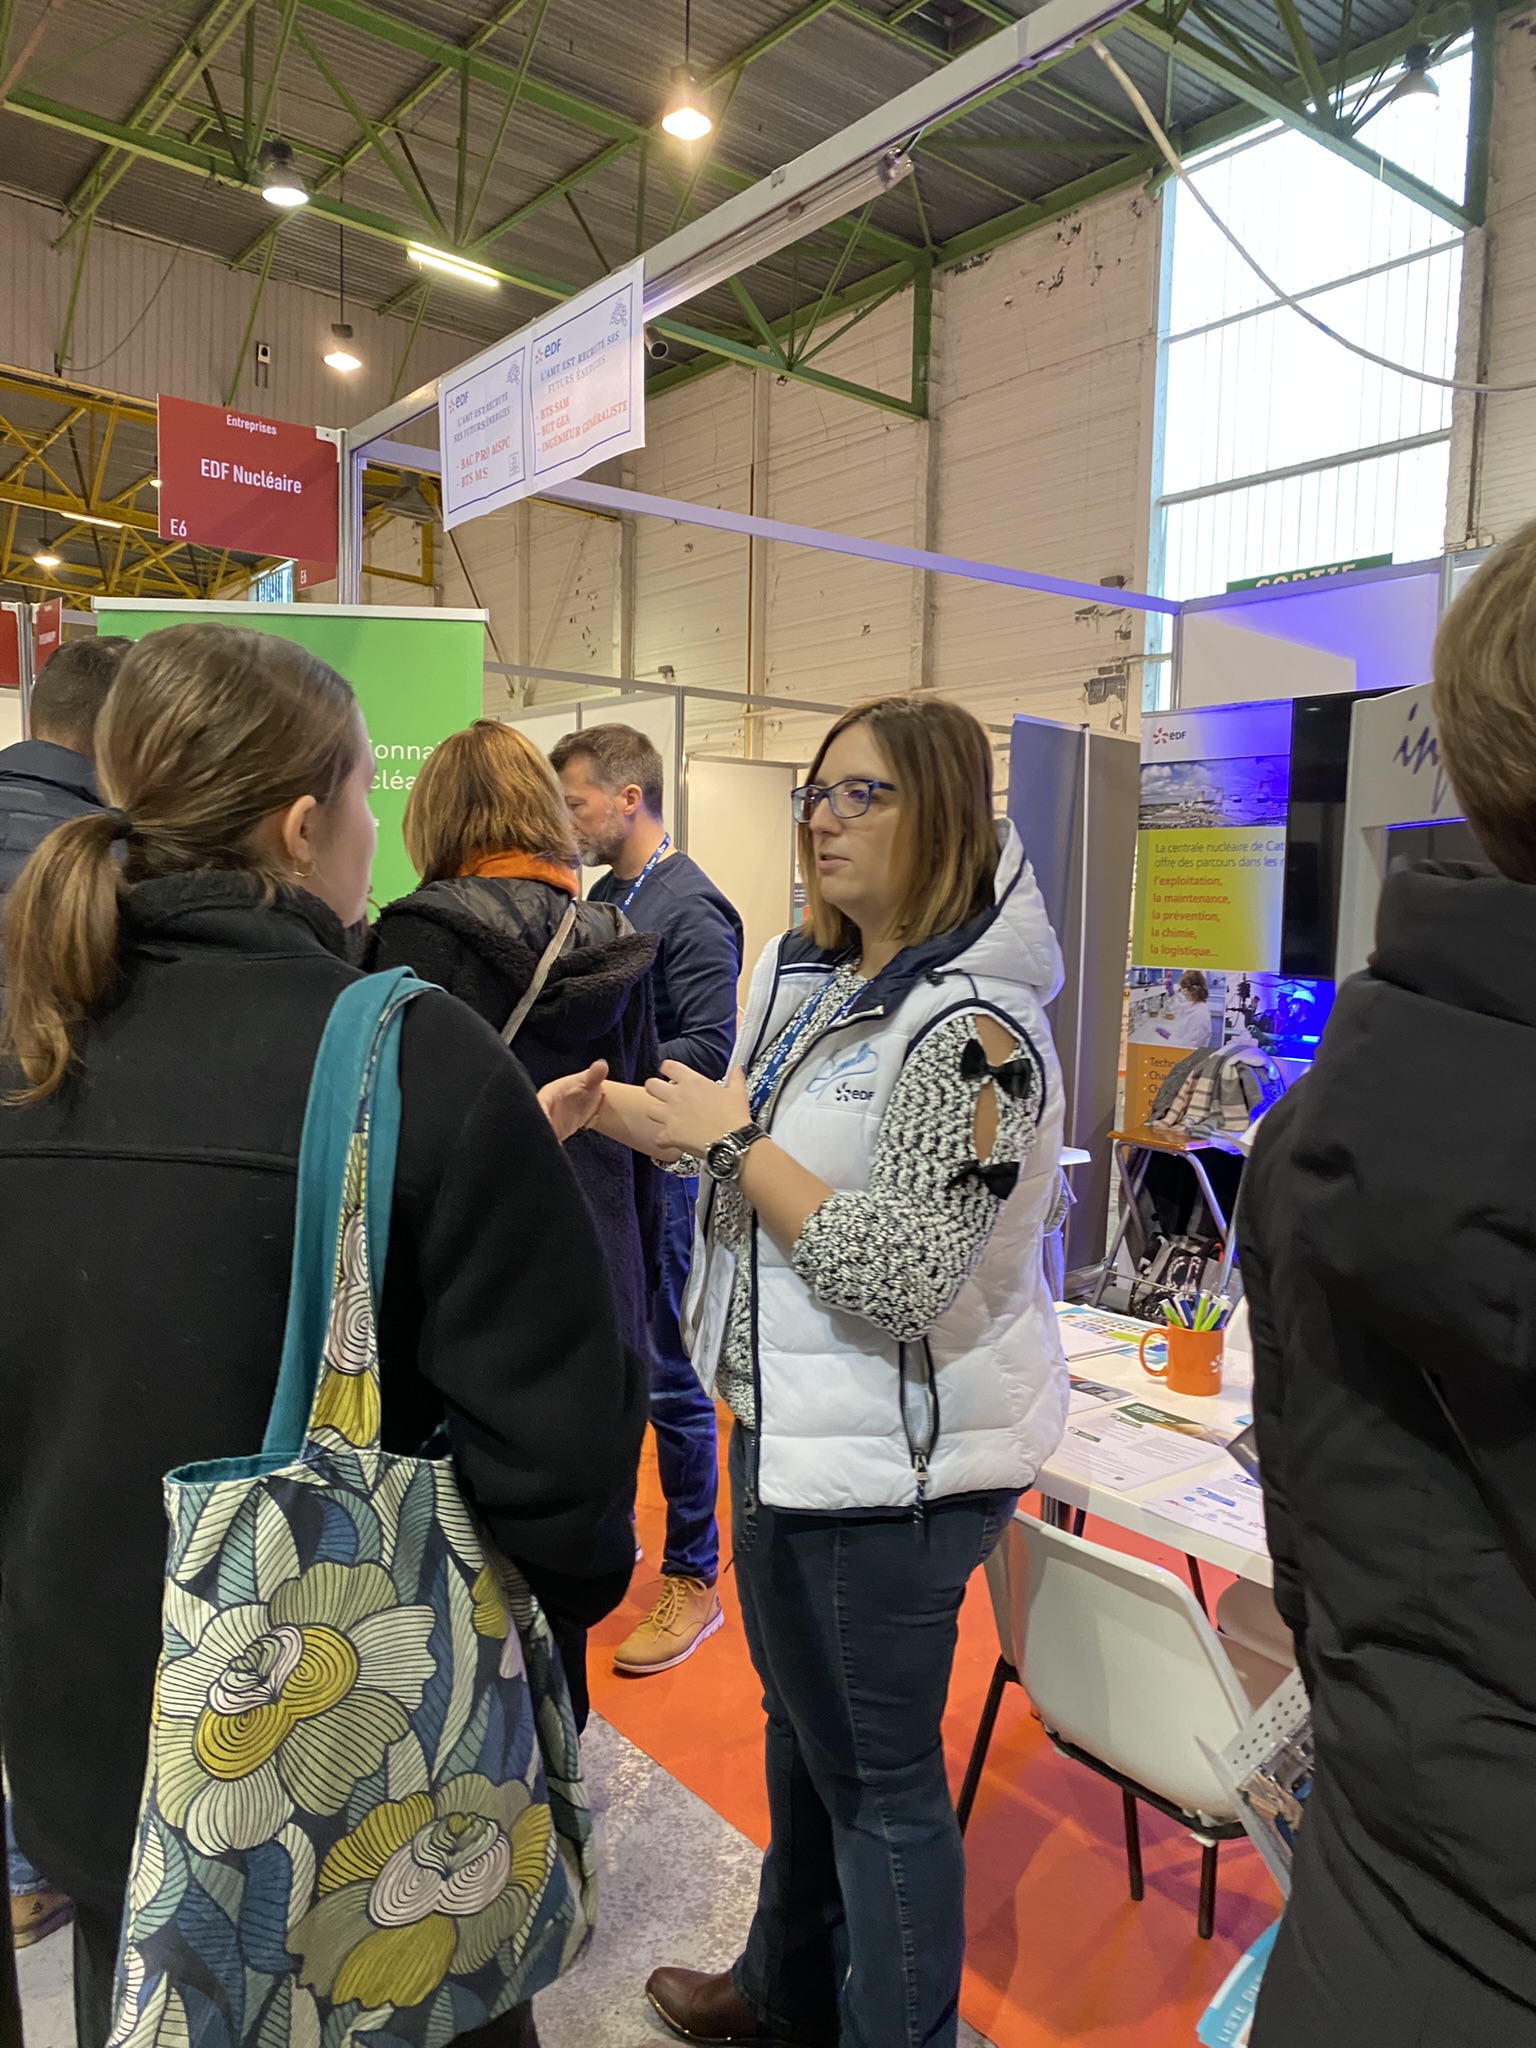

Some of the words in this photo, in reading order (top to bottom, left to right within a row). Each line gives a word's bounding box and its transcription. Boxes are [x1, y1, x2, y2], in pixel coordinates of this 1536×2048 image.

[606, 330, 620, 346] SES
[547, 374, 574, 394] FUTURS
[540, 403, 554, 420] BTS
[226, 414, 277, 436] Entreprises
[461, 453, 474, 470] BAC
[200, 458, 230, 480] EDF
[233, 464, 302, 494] Nucléaire
[461, 470, 474, 488] BTS
[170, 518, 188, 537] E6
[1156, 843, 1165, 853] La
[1168, 841, 1203, 853] centrale
[1206, 840, 1248, 852] nucléaire
[1251, 840, 1263, 851] de
[1155, 856, 1175, 868] offre
[1178, 856, 1194, 868] des
[1196, 858, 1236, 870] parcours
[1238, 856, 1261, 868] dans
[1263, 856, 1277, 867] les
[1153, 894, 1163, 903] la
[1164, 894, 1231, 906] maintenance,
[1152, 910, 1161, 920] la
[1163, 909, 1221, 923] prévention,
[1151, 928, 1160, 937] la
[1162, 927, 1197, 940] chimie,
[1150, 945, 1159, 954] la
